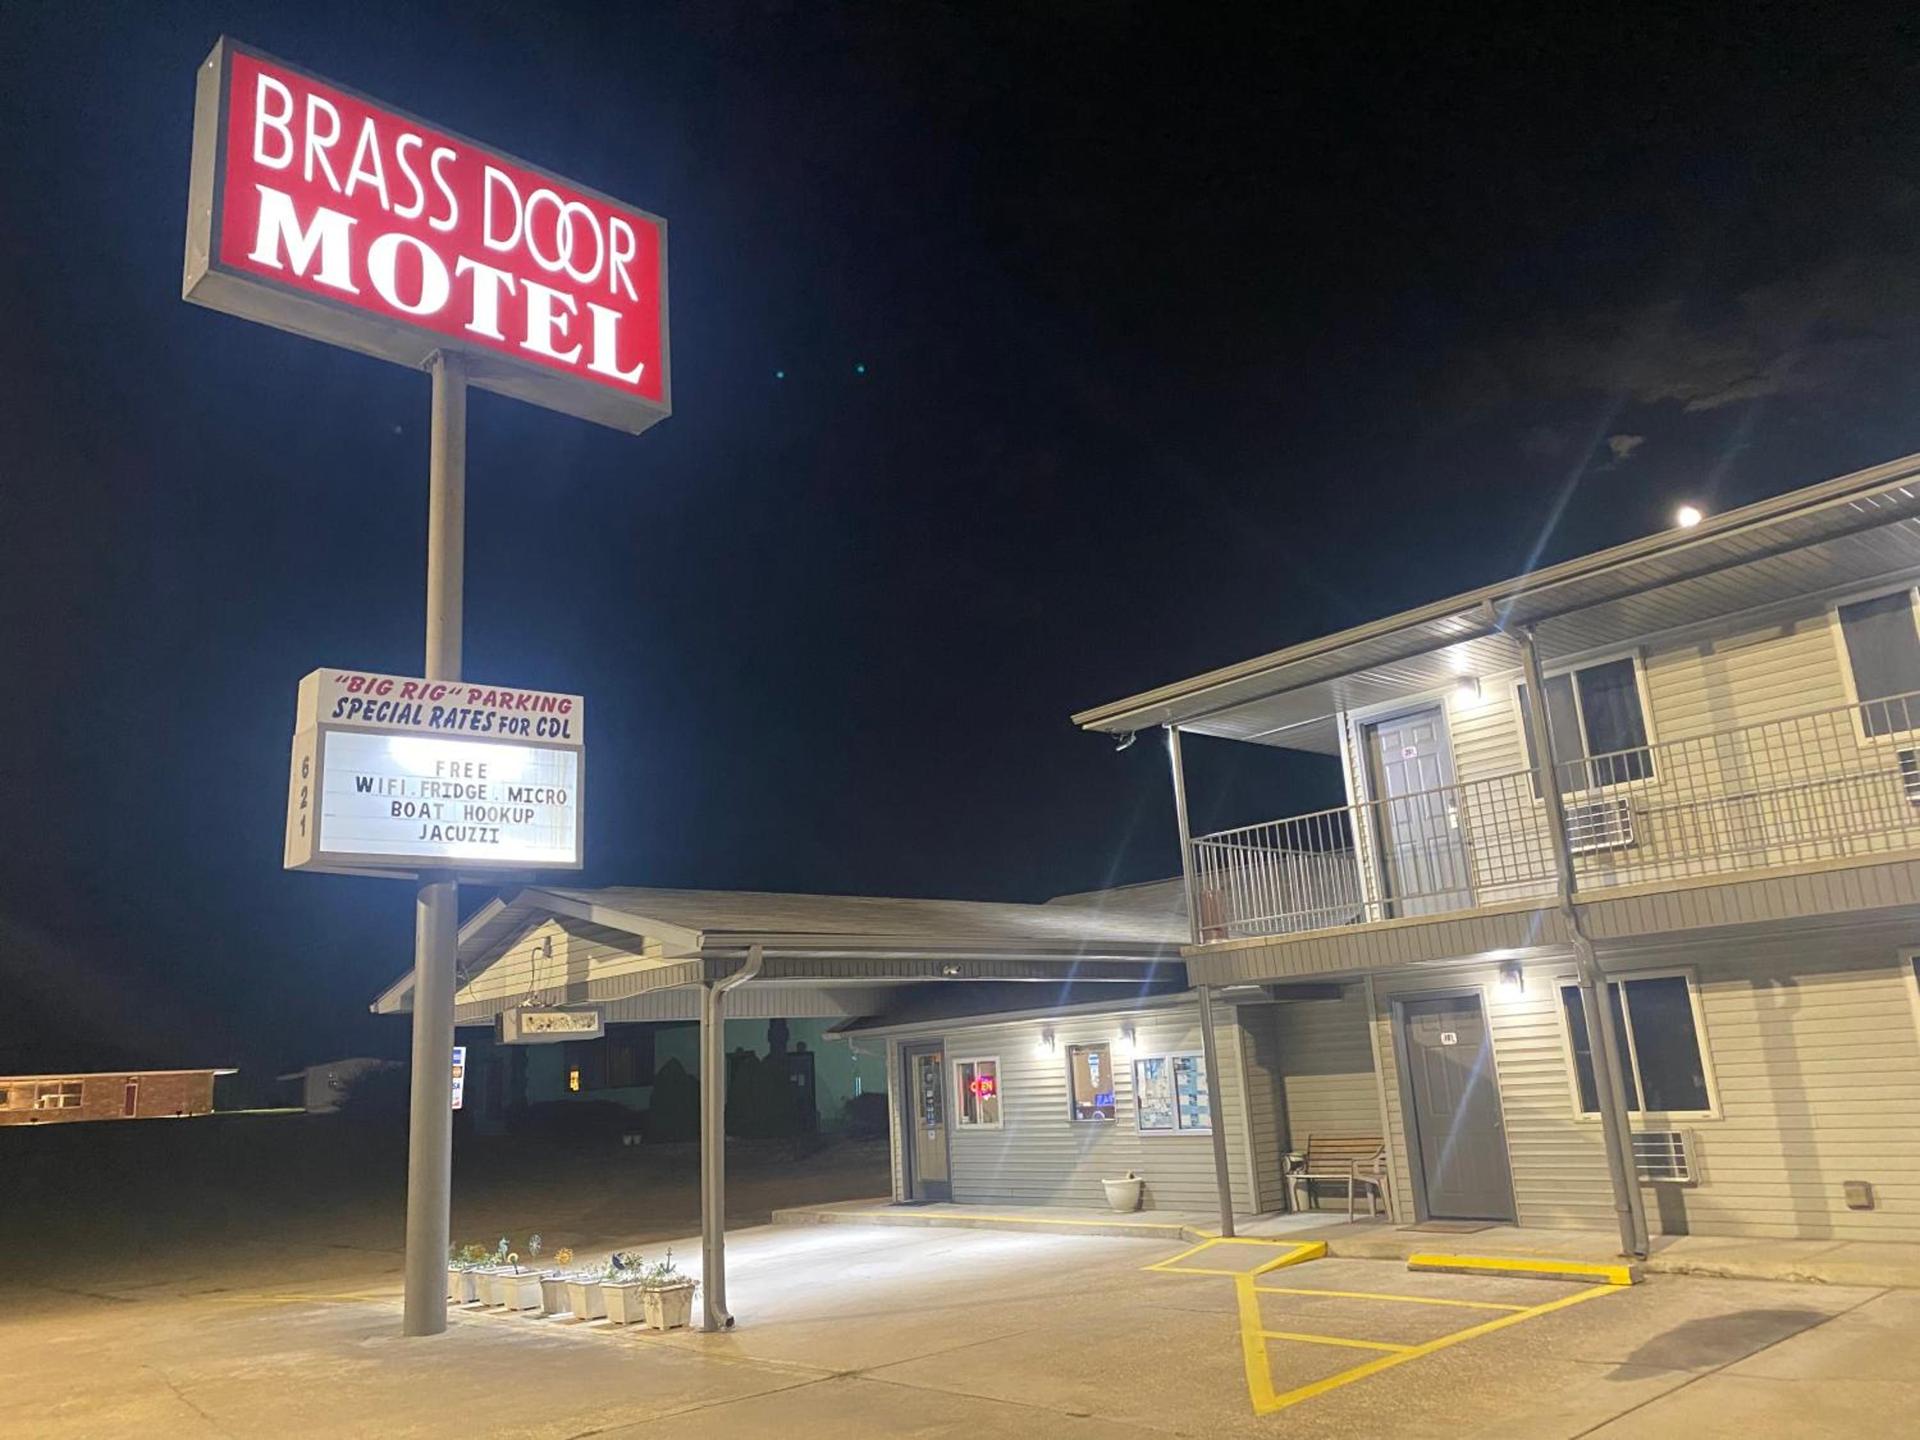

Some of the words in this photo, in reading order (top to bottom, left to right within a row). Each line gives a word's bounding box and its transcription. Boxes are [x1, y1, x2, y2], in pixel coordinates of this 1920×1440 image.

[253, 73, 459, 232] BRASS
[484, 165, 639, 302] DOOR
[248, 183, 646, 385] MOTEL
[468, 688, 573, 715] PARKING
[332, 696, 422, 725] SPECIAL
[429, 706, 497, 732] RATES
[499, 716, 531, 736] FOR
[536, 717, 572, 739] CDL
[436, 760, 488, 779] FREE
[507, 787, 568, 805] MICRO
[390, 801, 445, 820] BOAT
[464, 805, 535, 824] HOOKUP
[418, 824, 500, 844] JACUZZI
[969, 1080, 994, 1094] OEN
